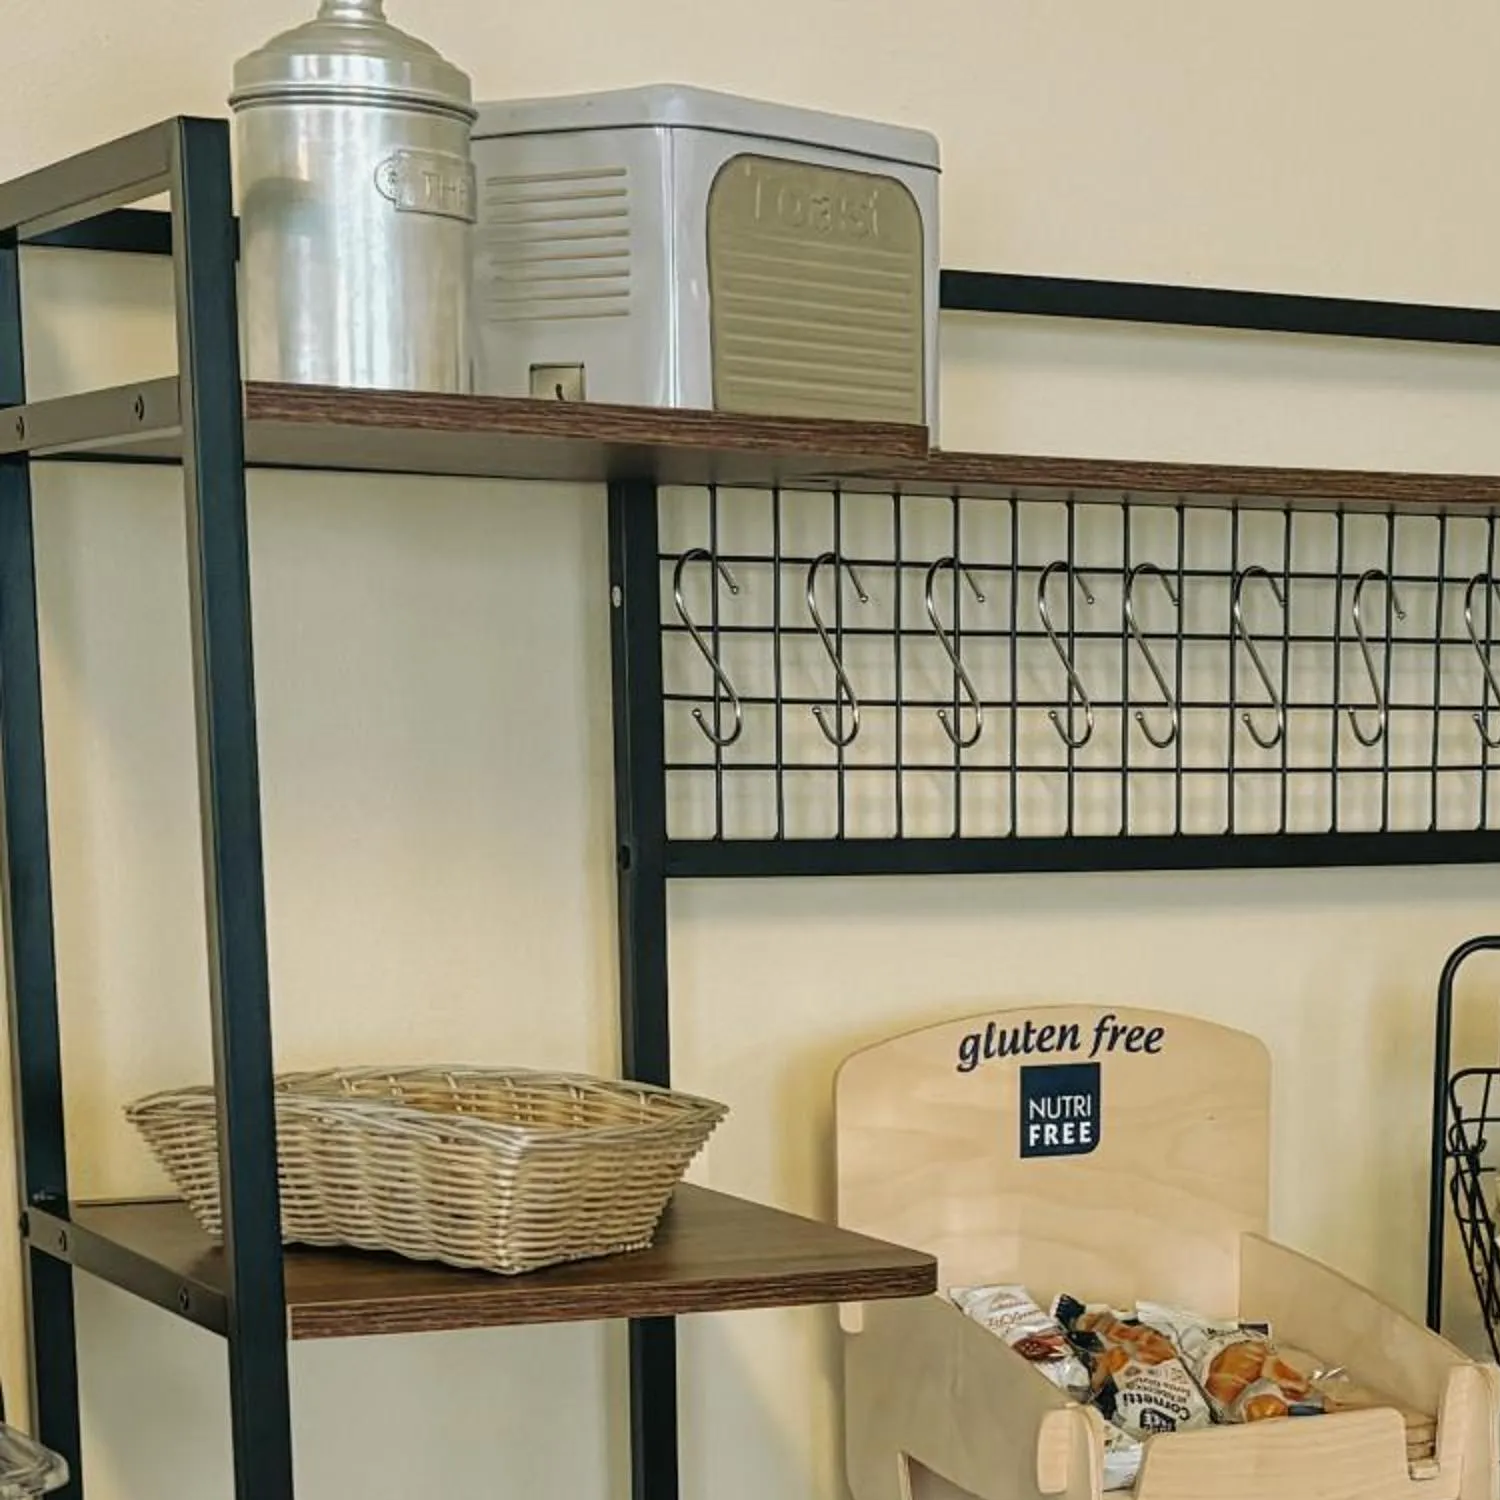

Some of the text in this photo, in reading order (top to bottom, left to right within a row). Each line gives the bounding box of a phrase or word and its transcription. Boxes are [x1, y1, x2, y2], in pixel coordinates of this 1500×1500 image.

[957, 1014, 1165, 1073] gluten free
[1029, 1094, 1091, 1121] NUTRI
[1029, 1121, 1092, 1147] FREE
[1123, 1393, 1191, 1421] Cornetti
